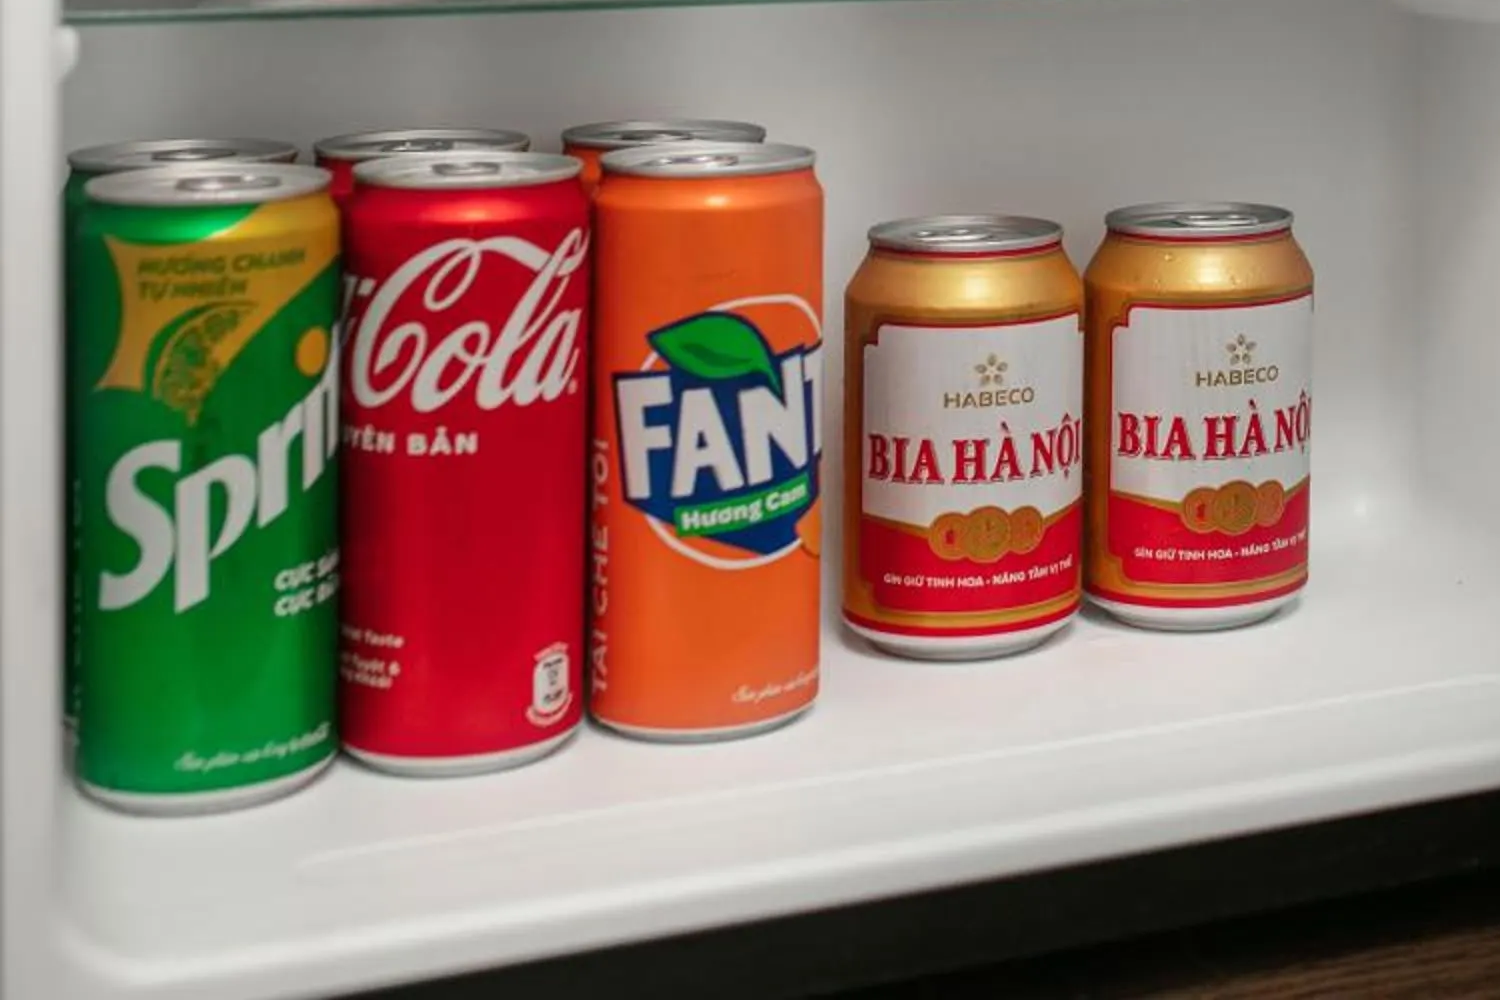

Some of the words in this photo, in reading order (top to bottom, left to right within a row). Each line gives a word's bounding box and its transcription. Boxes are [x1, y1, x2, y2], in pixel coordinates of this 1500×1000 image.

[1196, 365, 1279, 387] HABECO
[943, 387, 1035, 409] HABECO
[343, 423, 395, 455] YÊN
[1117, 412, 1196, 460] BIA
[1202, 398, 1270, 460] HÀ
[868, 432, 944, 485] BIA
[952, 421, 1024, 485] HÀ
[1029, 412, 1081, 479] NỘI
[681, 499, 762, 531] Hương
[765, 484, 806, 512] Cam
[1207, 548, 1233, 560] HOA
[957, 576, 984, 588] HOA
